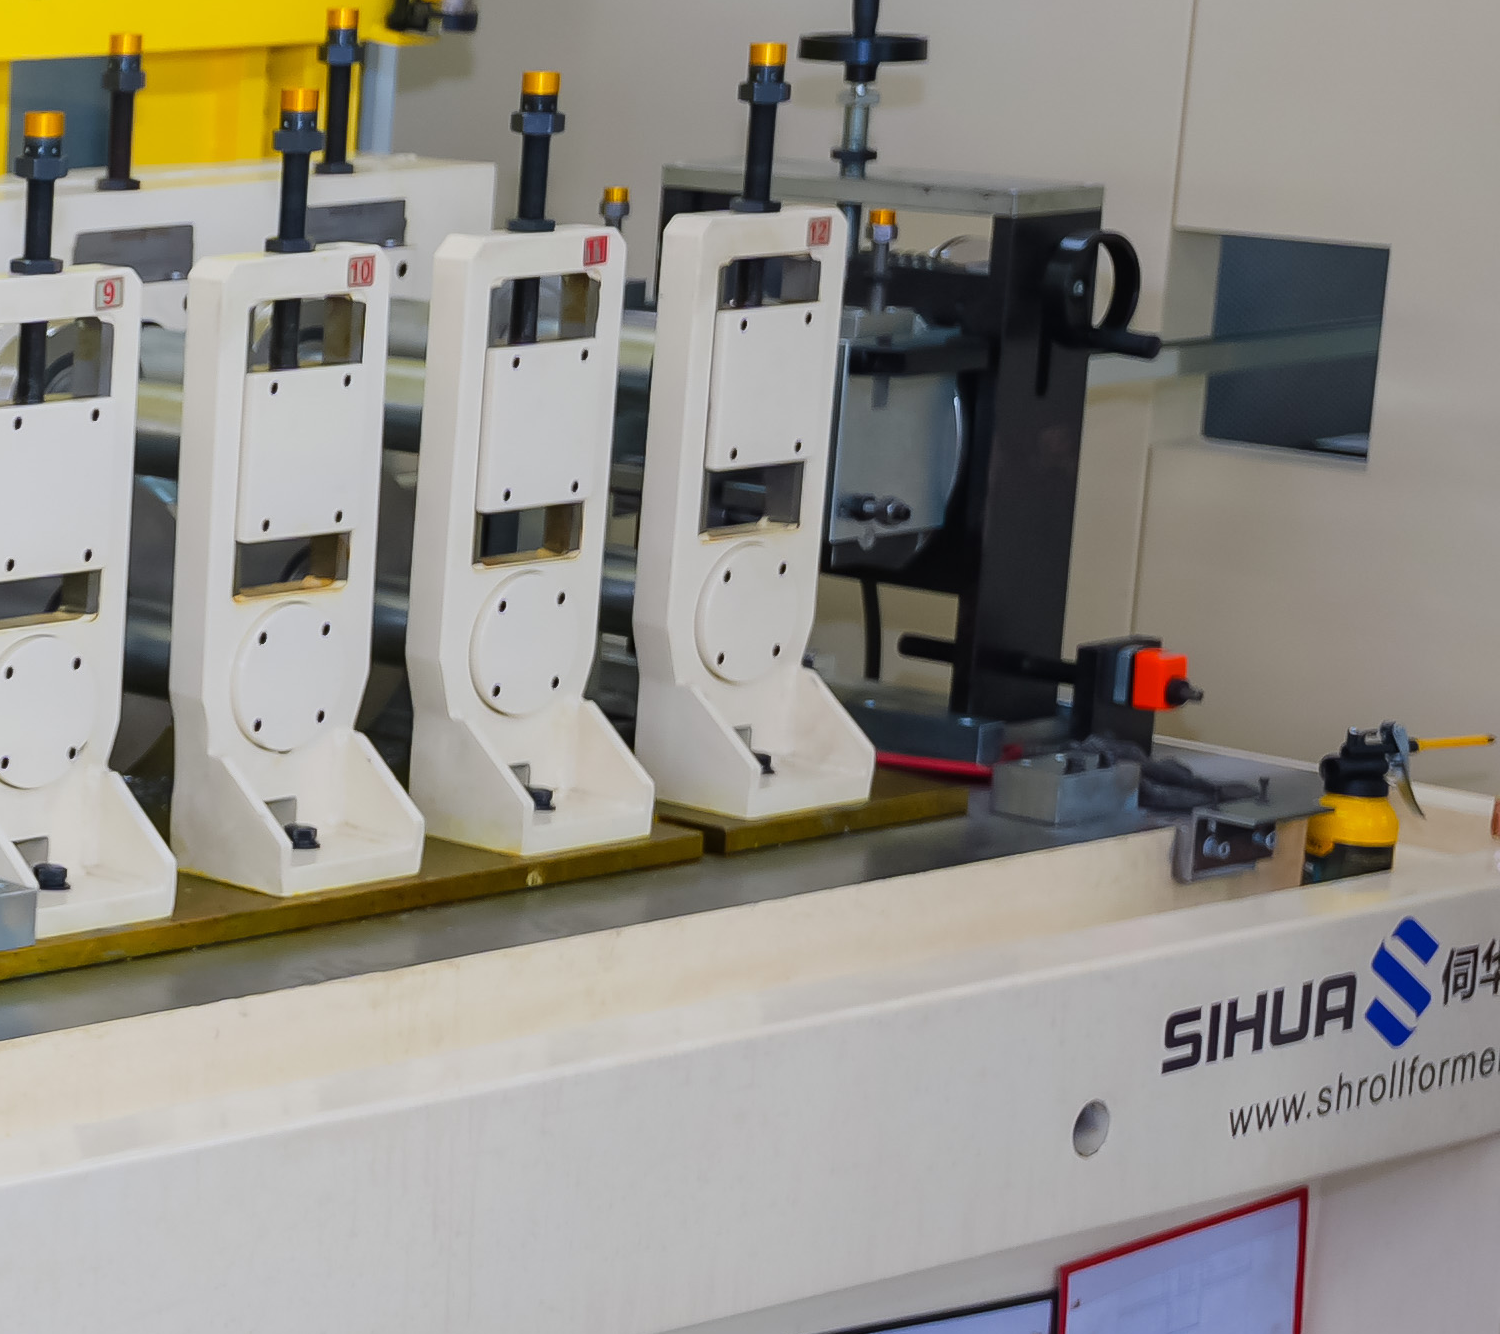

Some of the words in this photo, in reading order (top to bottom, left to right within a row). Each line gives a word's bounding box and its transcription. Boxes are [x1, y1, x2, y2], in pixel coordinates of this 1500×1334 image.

[810, 221, 827, 242] 12
[587, 237, 605, 262] 11
[351, 260, 370, 283] 10
[103, 281, 114, 304] 9
[1161, 971, 1357, 1075] SIHUA
[1229, 1046, 1500, 1138] www.shrollforme
